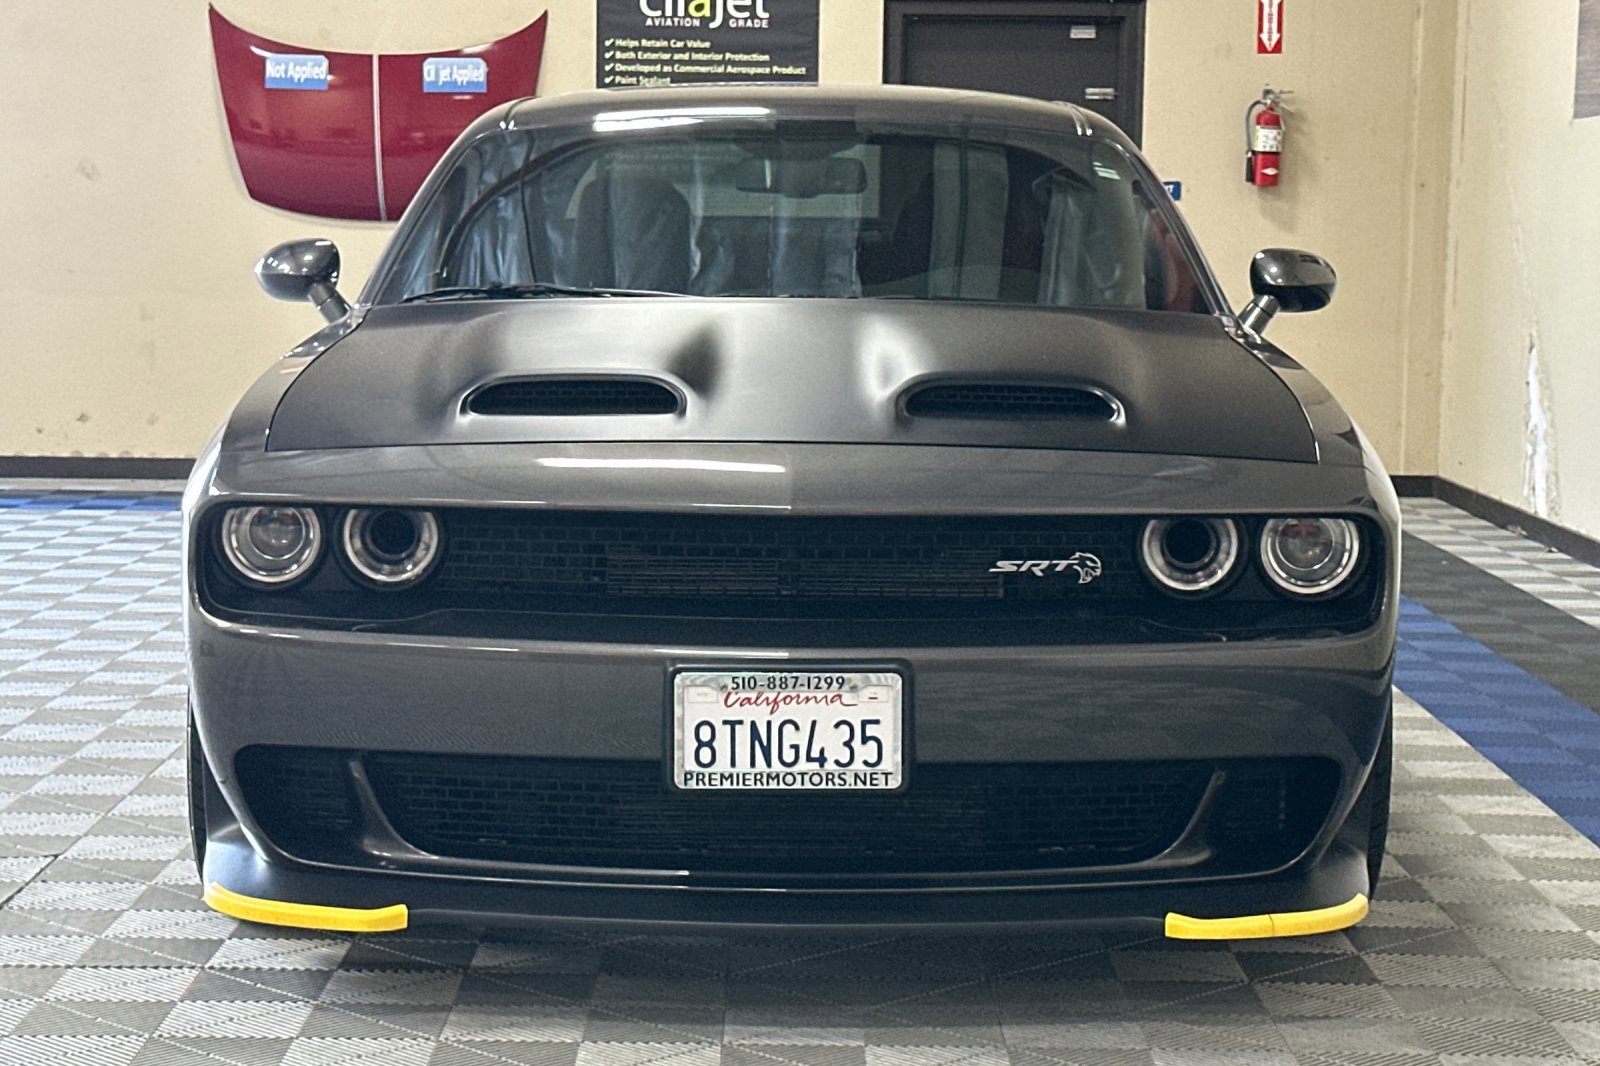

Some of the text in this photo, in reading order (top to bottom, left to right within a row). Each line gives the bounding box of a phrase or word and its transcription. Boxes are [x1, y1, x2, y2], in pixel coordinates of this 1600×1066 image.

[645, 17, 769, 28] AVIATION GRADE
[615, 39, 711, 48] Helps Retain Car Value
[615, 51, 770, 61] Both Exterior and Interior Protection
[265, 60, 328, 83] Not Applied
[452, 64, 485, 86] Applied
[615, 63, 806, 75] Developed as Commercial Aerospace Product
[615, 76, 637, 85] Paint
[988, 560, 1080, 577] SRT
[731, 676, 846, 690] 510-887-1299
[723, 690, 858, 715] California
[693, 718, 884, 769] 8TNG435
[683, 772, 893, 787] PREMIERMOTORS.NET
